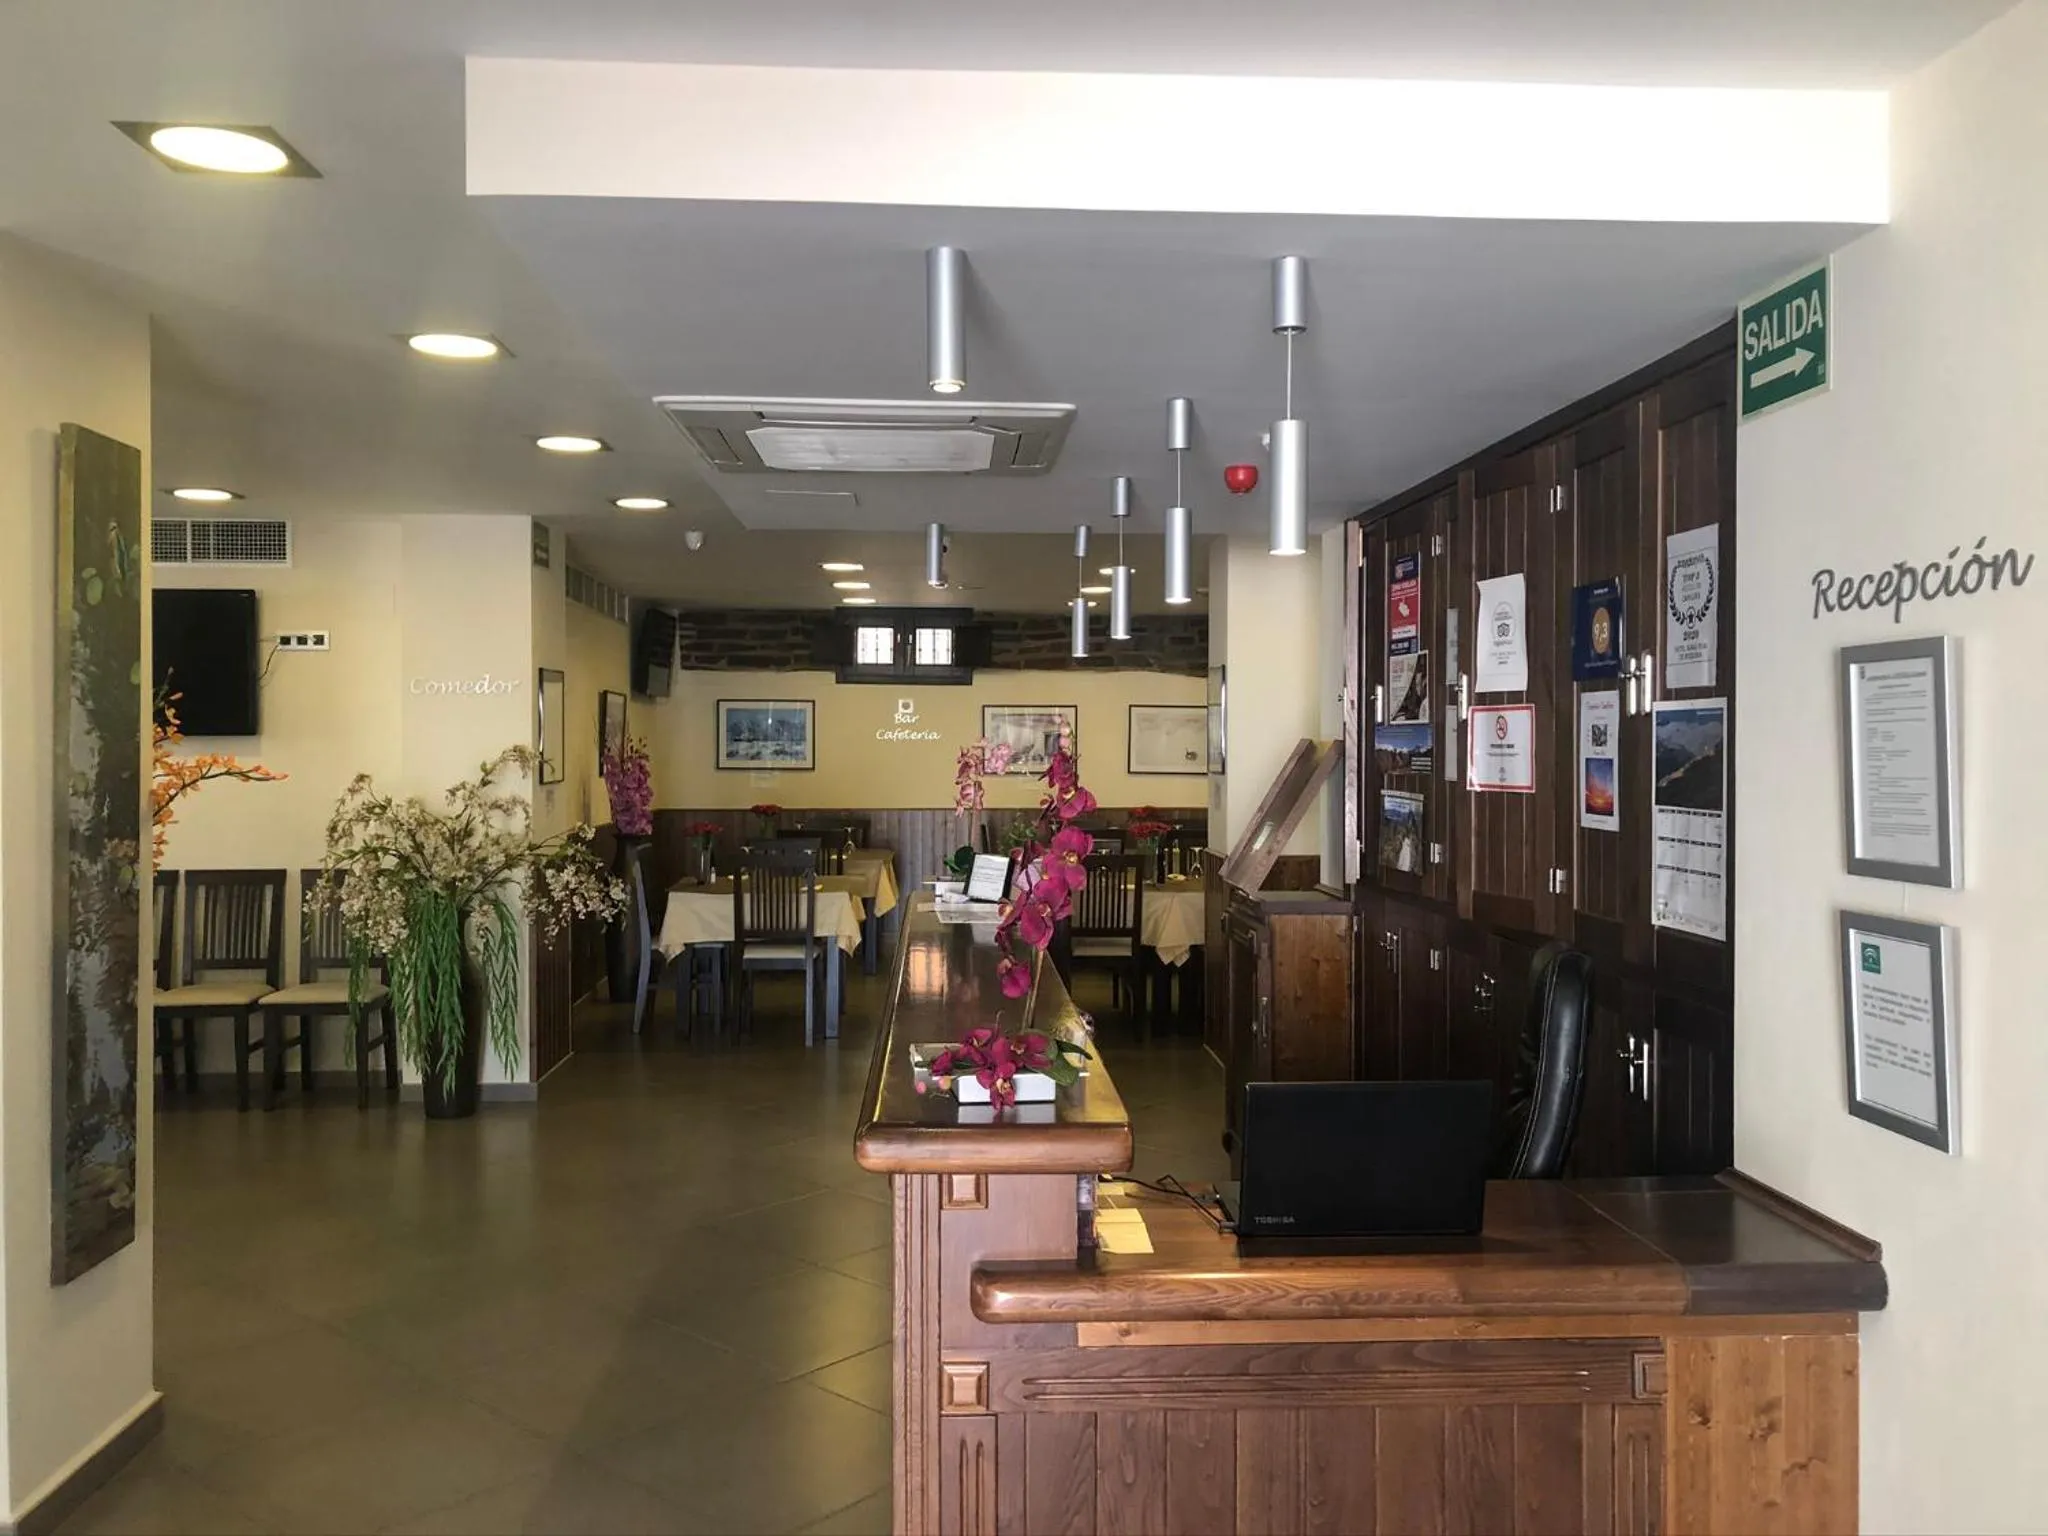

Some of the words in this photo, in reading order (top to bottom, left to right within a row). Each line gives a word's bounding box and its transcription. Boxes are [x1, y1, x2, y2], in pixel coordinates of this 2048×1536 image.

[1744, 289, 1824, 361] SALIDA
[1811, 536, 2035, 624] Recepción
[409, 673, 522, 695] Comedor
[894, 711, 920, 724] Bar
[875, 727, 941, 742] Cafeteria
[1253, 1215, 1296, 1225] TOSHIBA
